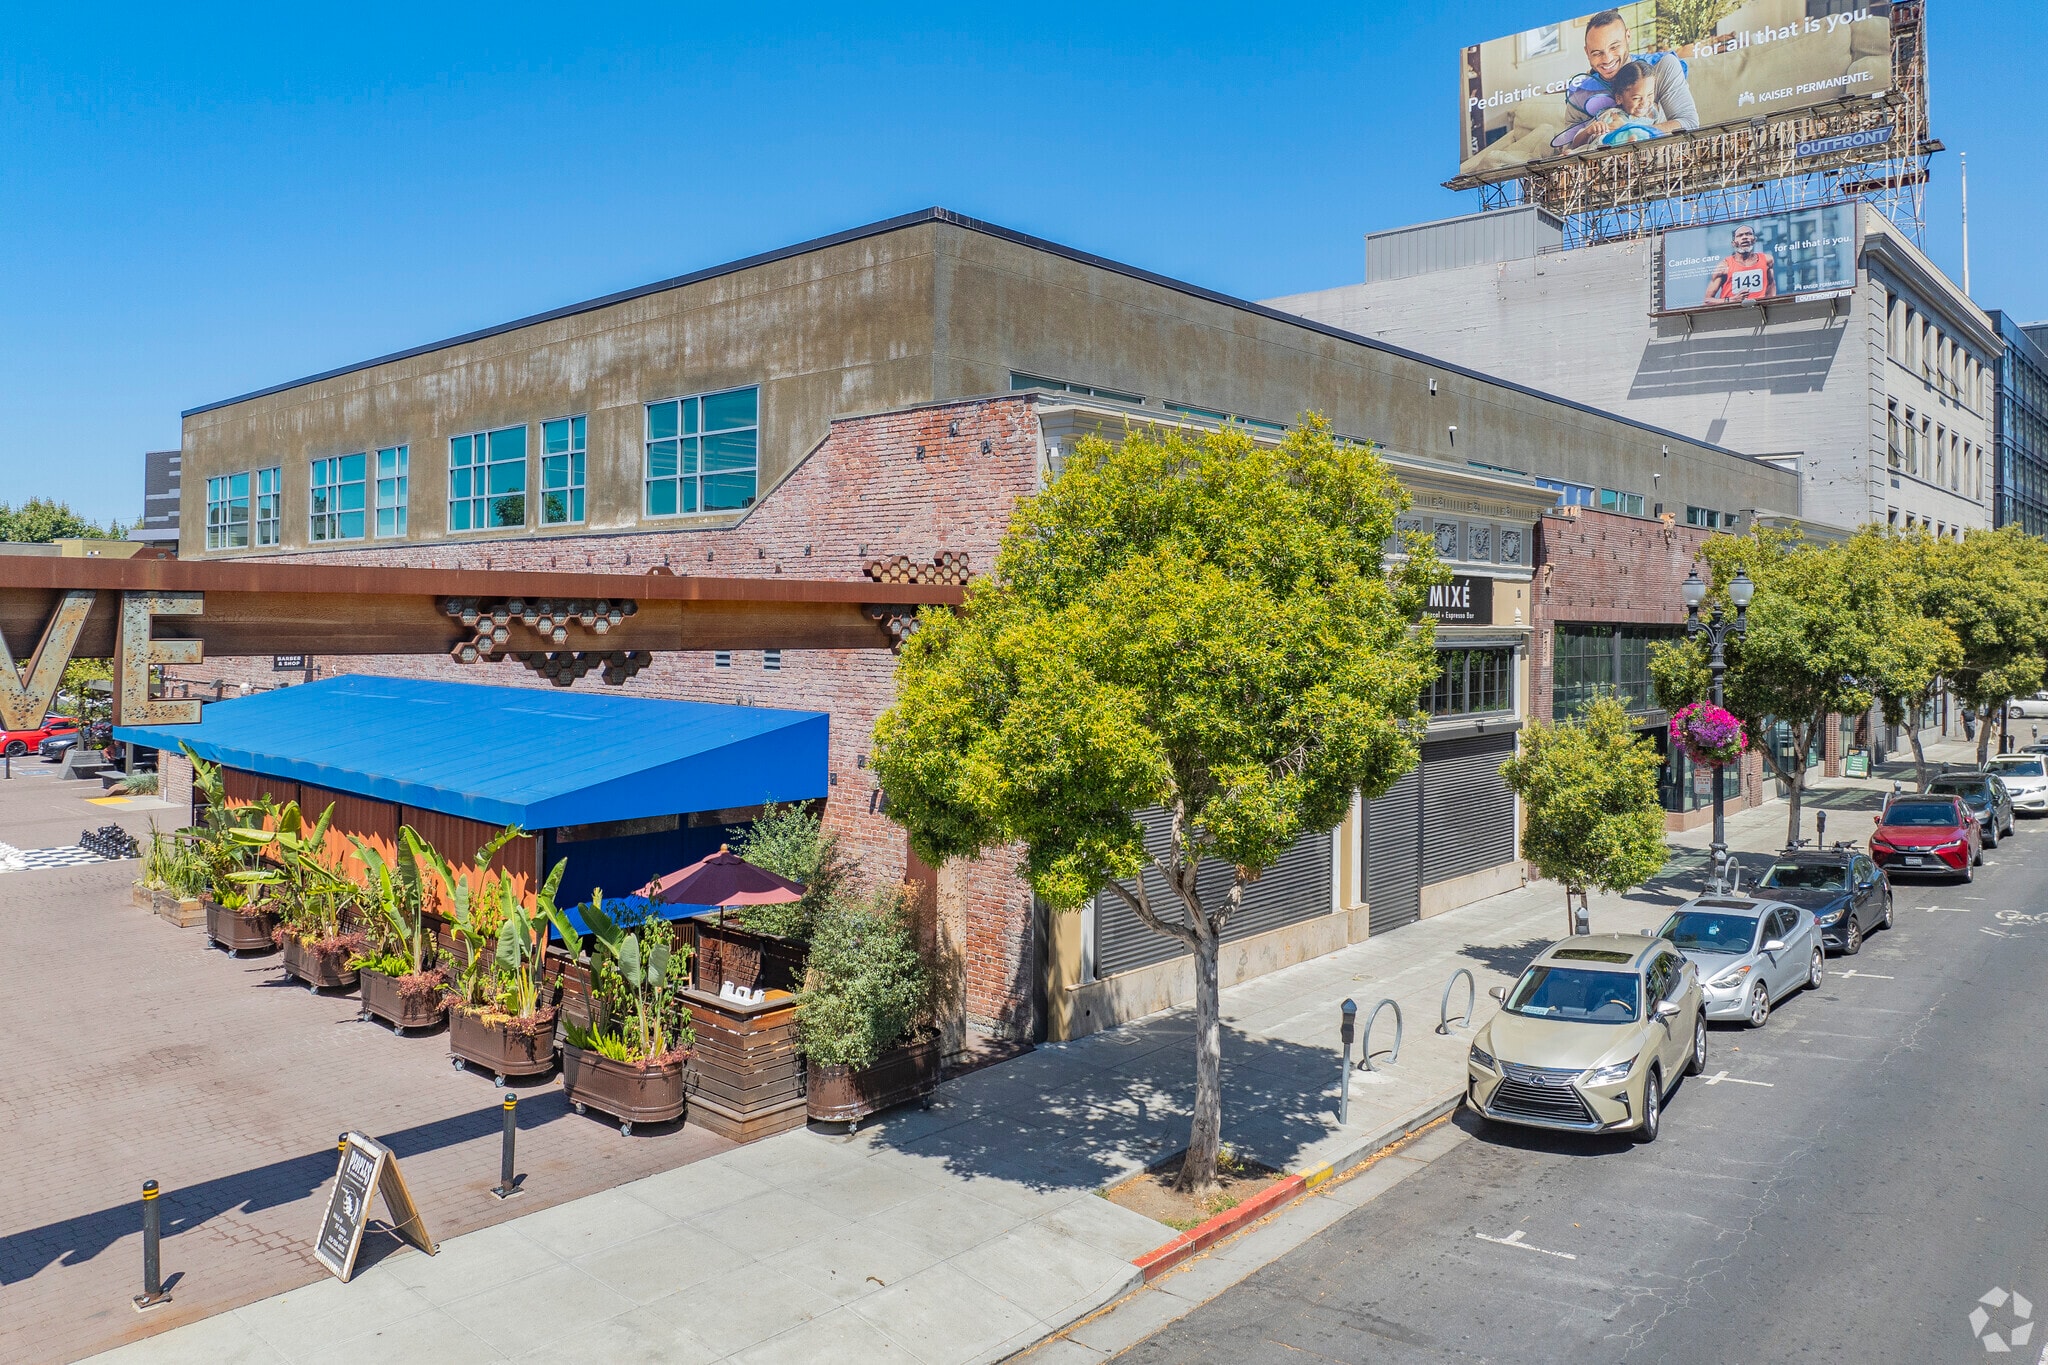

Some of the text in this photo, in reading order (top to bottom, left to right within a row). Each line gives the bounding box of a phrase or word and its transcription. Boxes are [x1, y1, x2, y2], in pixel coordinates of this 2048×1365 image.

[1692, 7, 1873, 59] for all that is you.
[1468, 77, 1583, 112] Pediatric care
[1758, 87, 1793, 102] KAISER
[1799, 129, 1888, 154] OUTFRONT
[1774, 236, 1852, 252] for all that is you.
[1668, 257, 1700, 268] Cardiac
[1734, 274, 1760, 289] 143
[1429, 579, 1470, 608] MIXÉ
[1445, 611, 1465, 620] Espresso
[1466, 611, 1475, 619] Bar
[347, 1150, 373, 1186] PEOPLES
